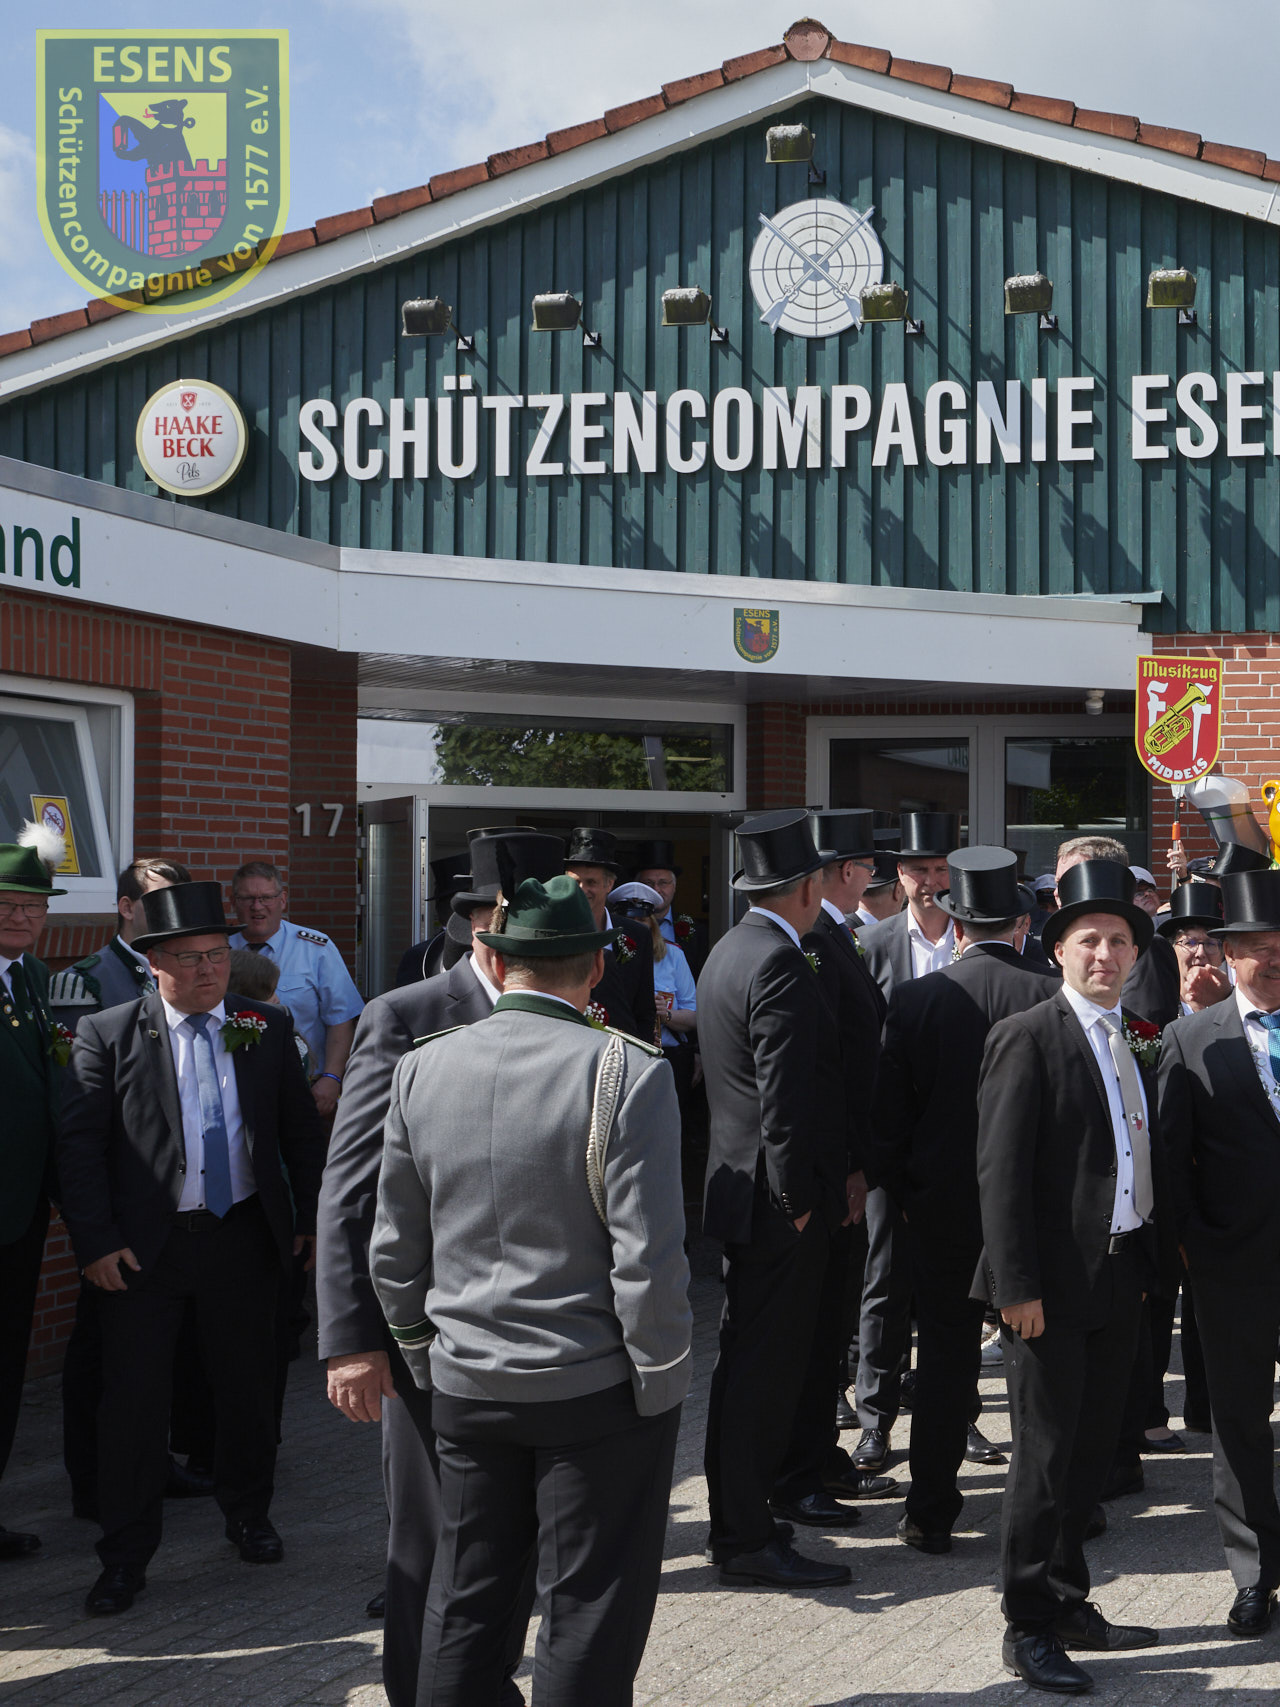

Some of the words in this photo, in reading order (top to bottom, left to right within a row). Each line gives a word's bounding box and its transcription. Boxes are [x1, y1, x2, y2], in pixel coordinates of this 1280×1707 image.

[154, 415, 224, 436] HAAKE
[298, 375, 1095, 482] SCHÜTZENCOMPAGNIE
[163, 438, 216, 458] BECK
[176, 462, 201, 481] Pils
[0, 516, 80, 588] nd
[743, 608, 771, 618] ESENS
[1142, 660, 1218, 683] Musikzug
[1147, 757, 1208, 781] MIDDELS
[295, 802, 344, 837] 17
